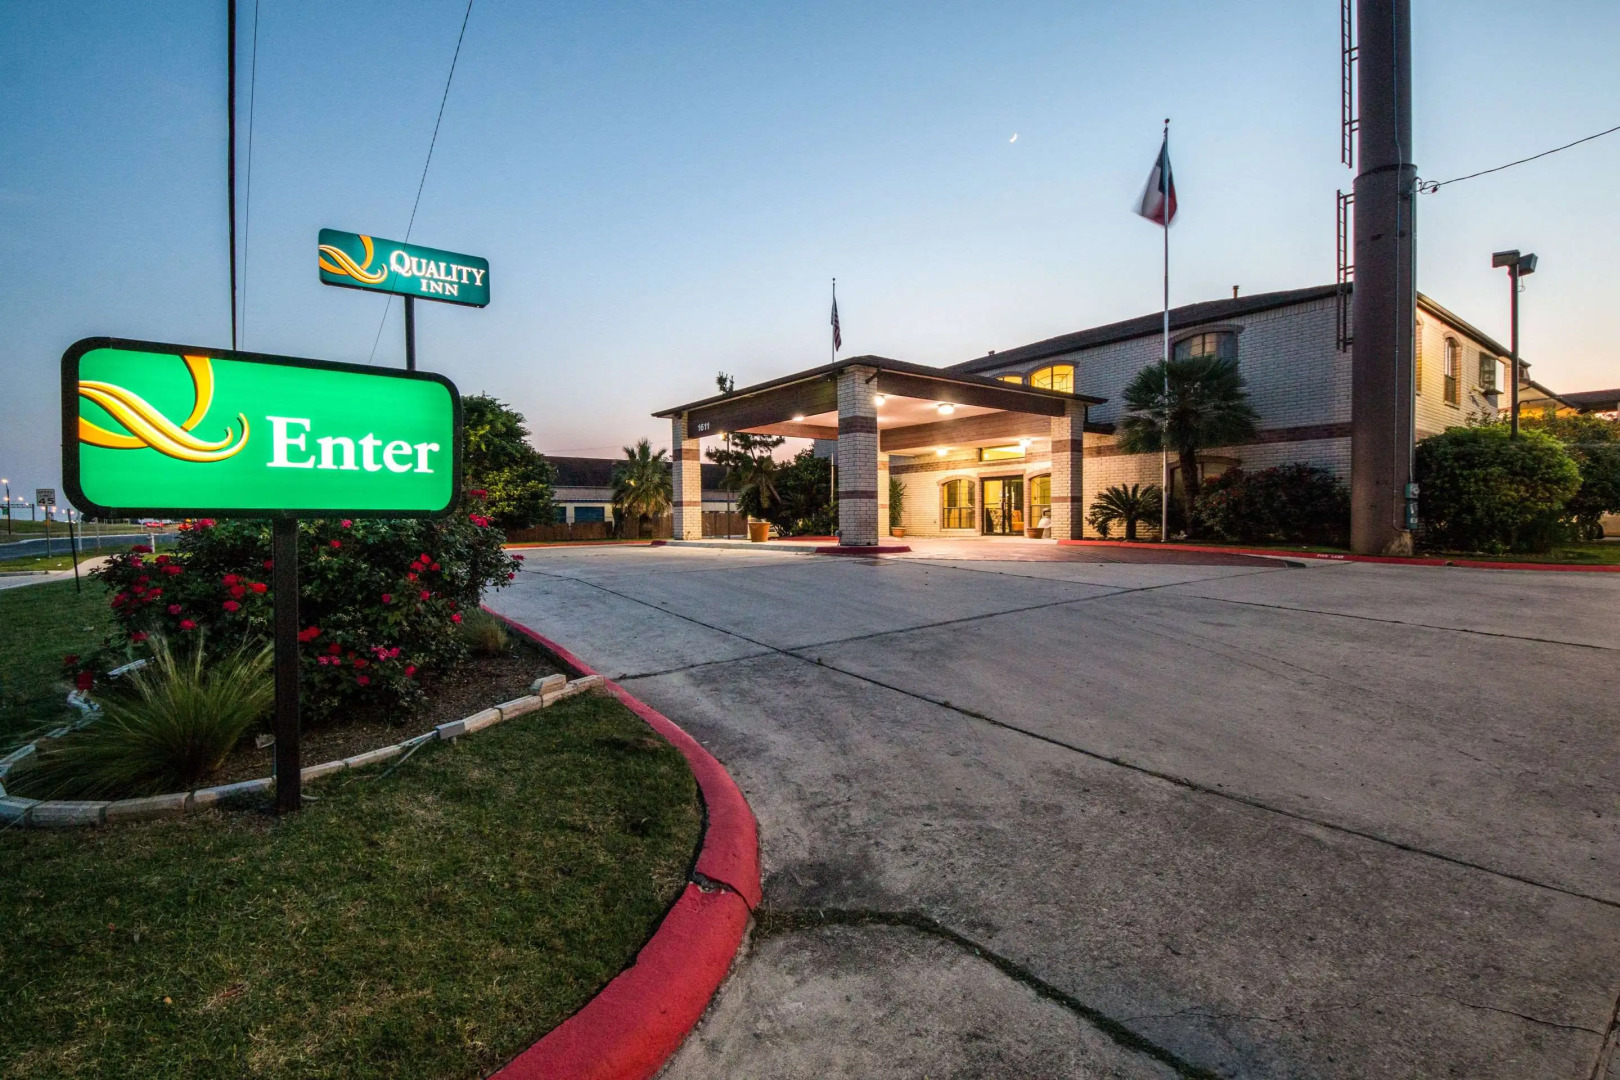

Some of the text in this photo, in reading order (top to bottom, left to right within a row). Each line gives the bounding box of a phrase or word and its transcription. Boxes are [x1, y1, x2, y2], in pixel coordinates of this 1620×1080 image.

[389, 250, 486, 286] QUALITY
[420, 278, 459, 297] INN
[698, 421, 709, 431] 1611
[265, 415, 440, 473] Enter
